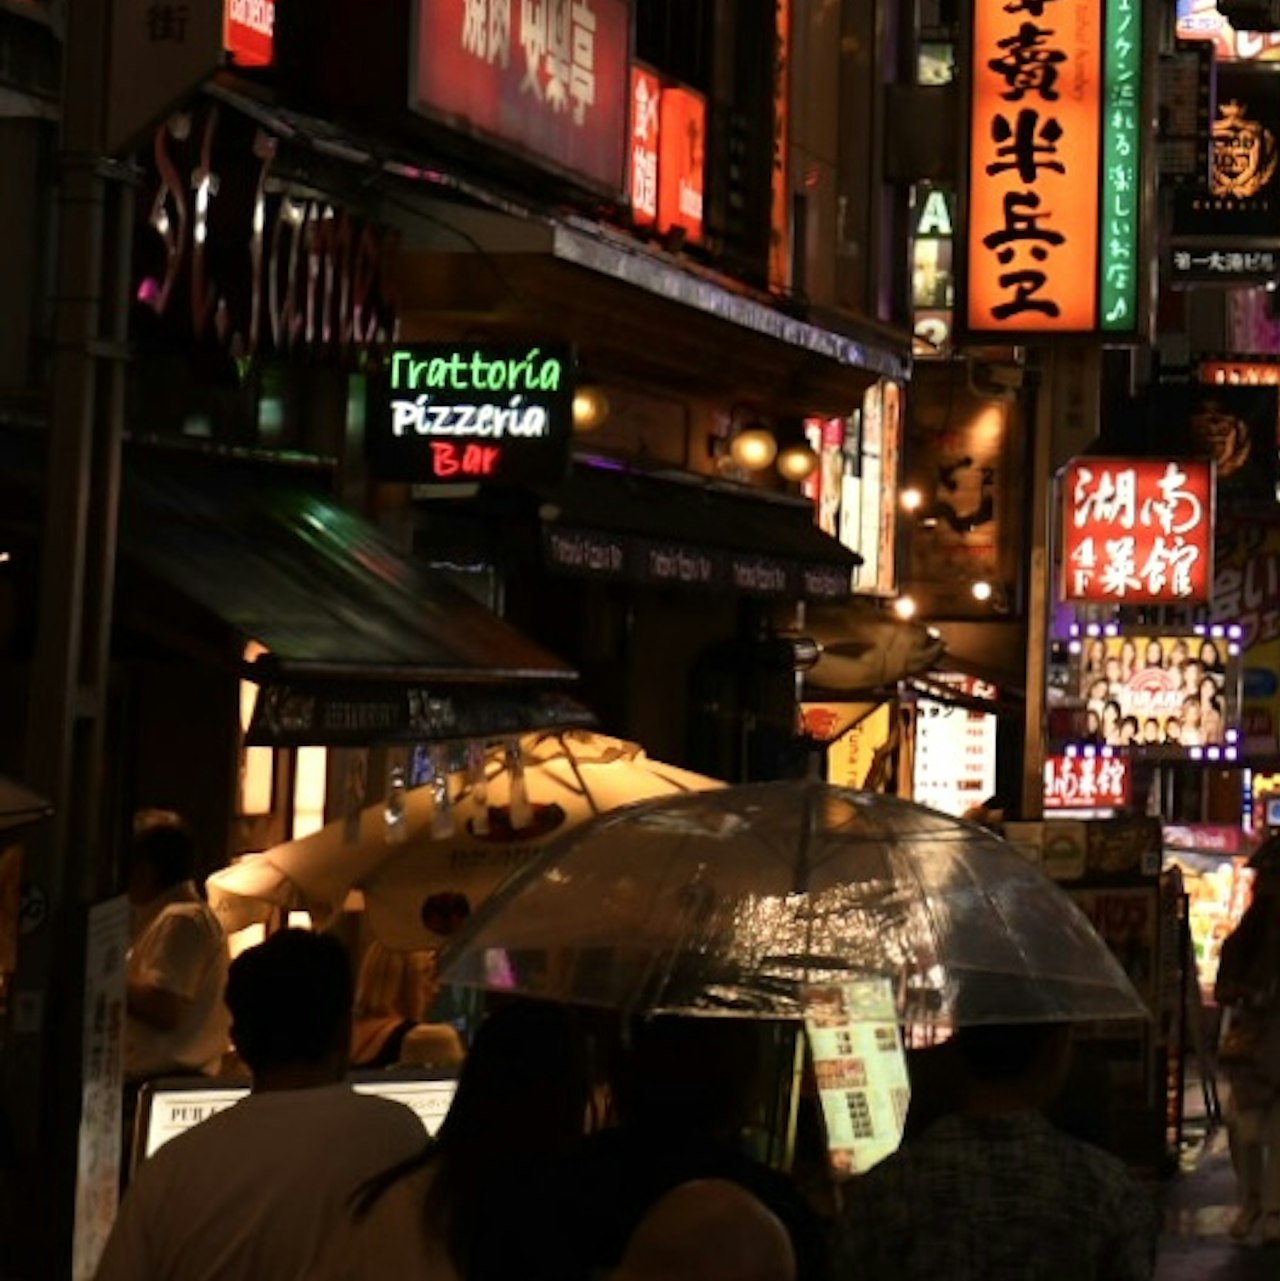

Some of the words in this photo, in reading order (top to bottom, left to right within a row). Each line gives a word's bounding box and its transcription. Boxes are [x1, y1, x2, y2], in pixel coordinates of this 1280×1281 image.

[391, 348, 561, 391] Trattoria
[390, 394, 548, 438] Pizzeria
[430, 441, 499, 477] Bar
[1074, 463, 1201, 534] 湖南
